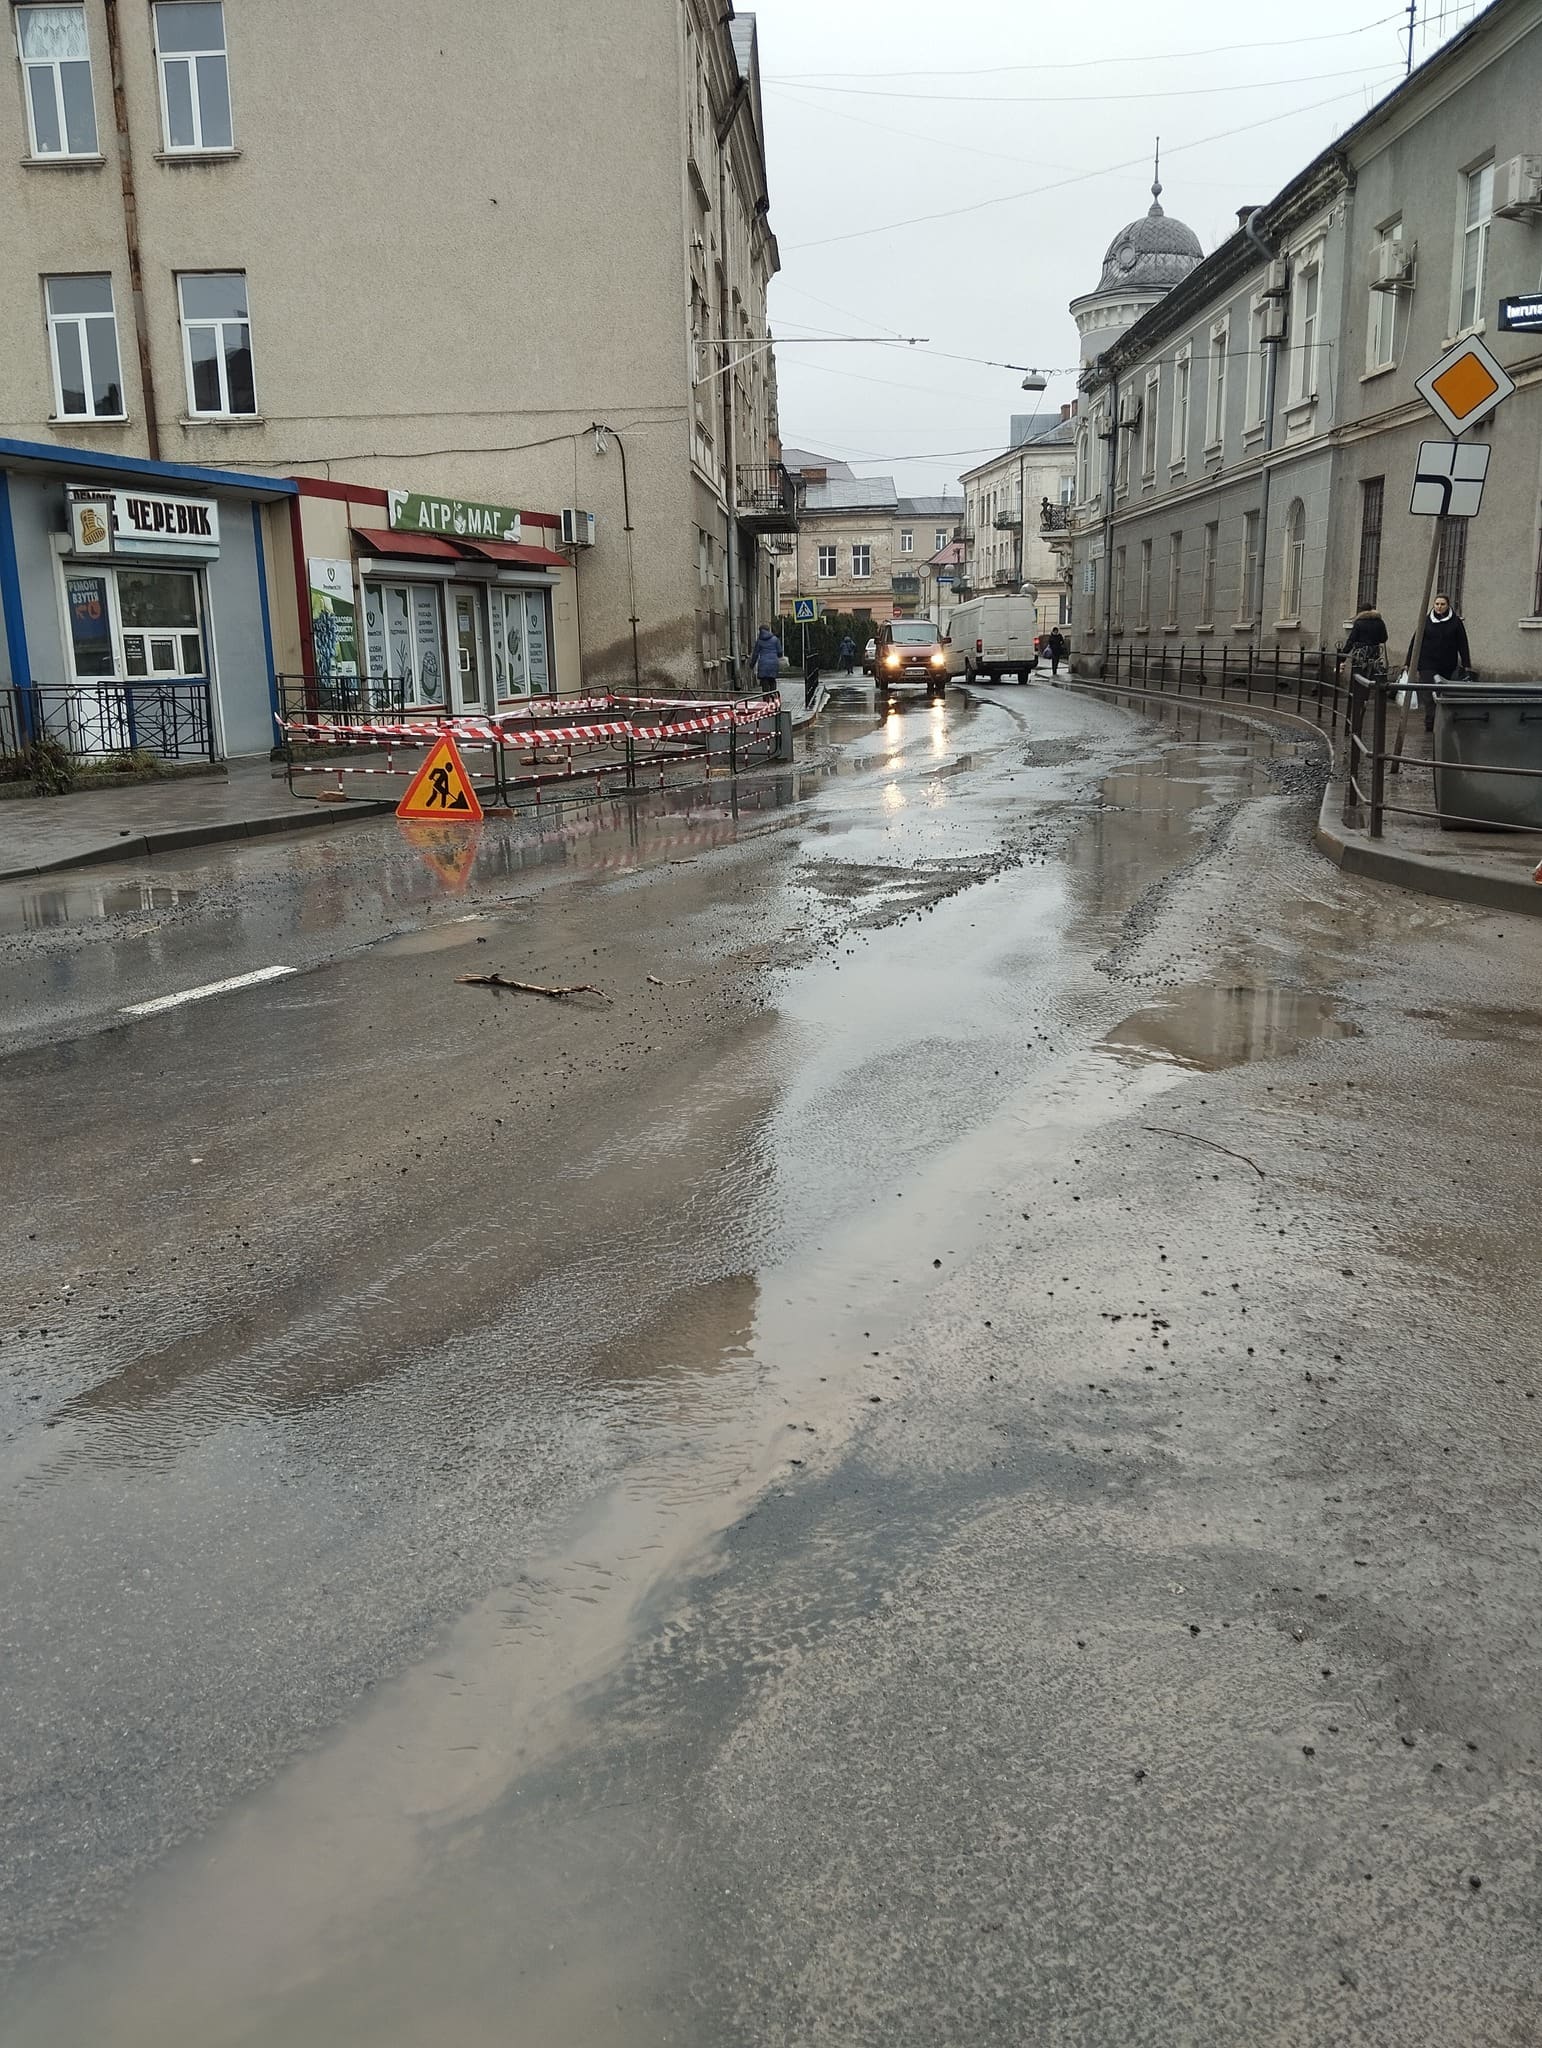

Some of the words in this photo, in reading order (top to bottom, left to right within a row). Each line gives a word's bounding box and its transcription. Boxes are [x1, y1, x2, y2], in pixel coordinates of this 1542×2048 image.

[126, 498, 212, 536] ЧЕРЕВИК
[72, 591, 99, 604] ВЗУТТЯ
[335, 625, 354, 633] АХИСТУ
